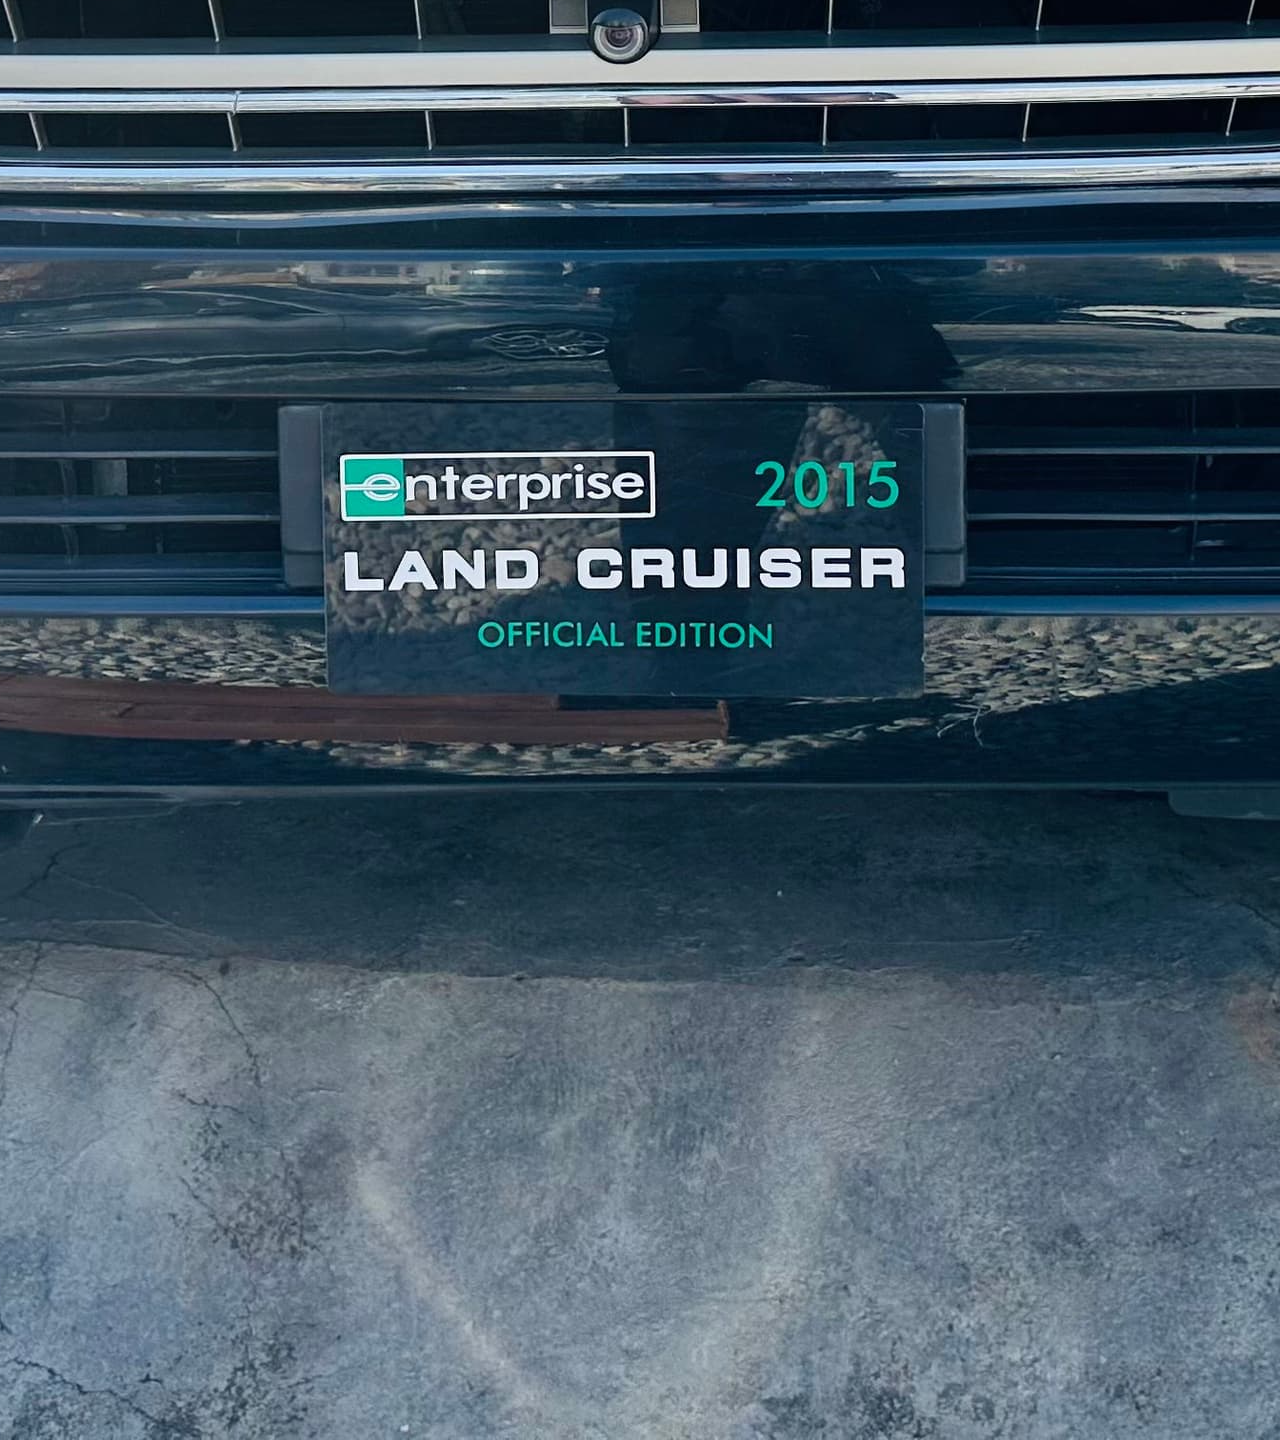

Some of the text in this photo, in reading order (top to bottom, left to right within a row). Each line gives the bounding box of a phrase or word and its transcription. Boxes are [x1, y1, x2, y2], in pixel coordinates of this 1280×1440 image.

[350, 463, 645, 510] enterprise
[754, 460, 899, 509] 2015
[343, 547, 906, 591] LAND CRUISER
[477, 621, 773, 649] OFFICIAL EDITION
